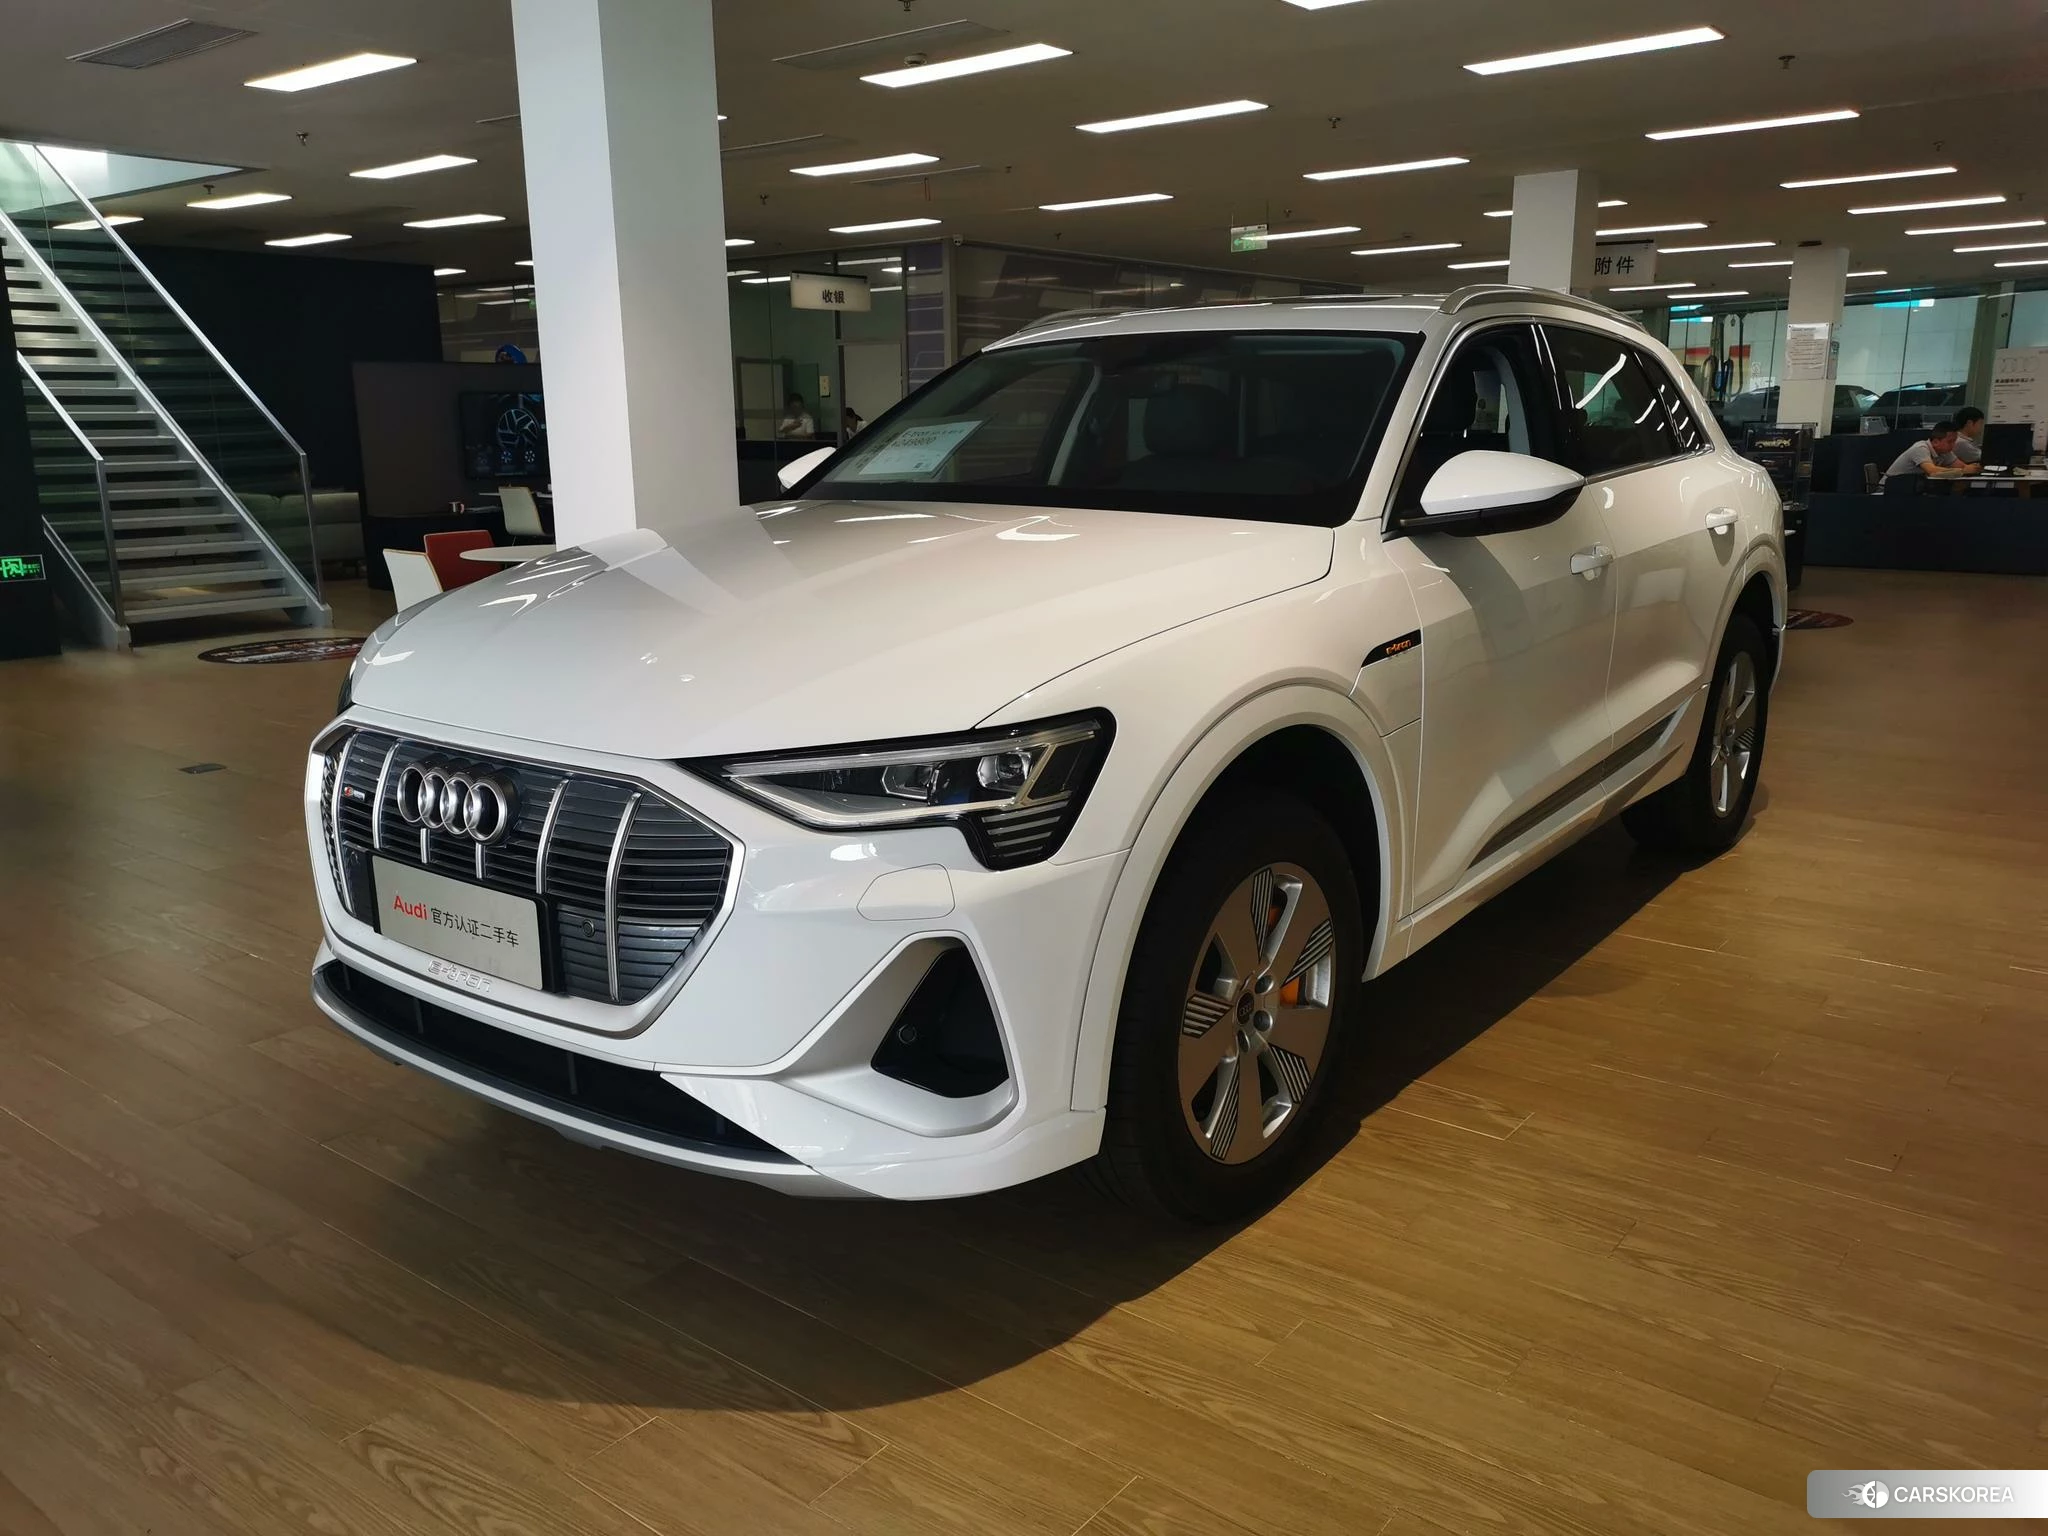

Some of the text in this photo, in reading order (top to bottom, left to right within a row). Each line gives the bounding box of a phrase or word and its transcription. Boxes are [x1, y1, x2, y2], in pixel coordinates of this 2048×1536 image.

[1594, 256, 1634, 275] 附件
[822, 289, 845, 304] 收银
[393, 895, 519, 947] Audi 官方认证二手车
